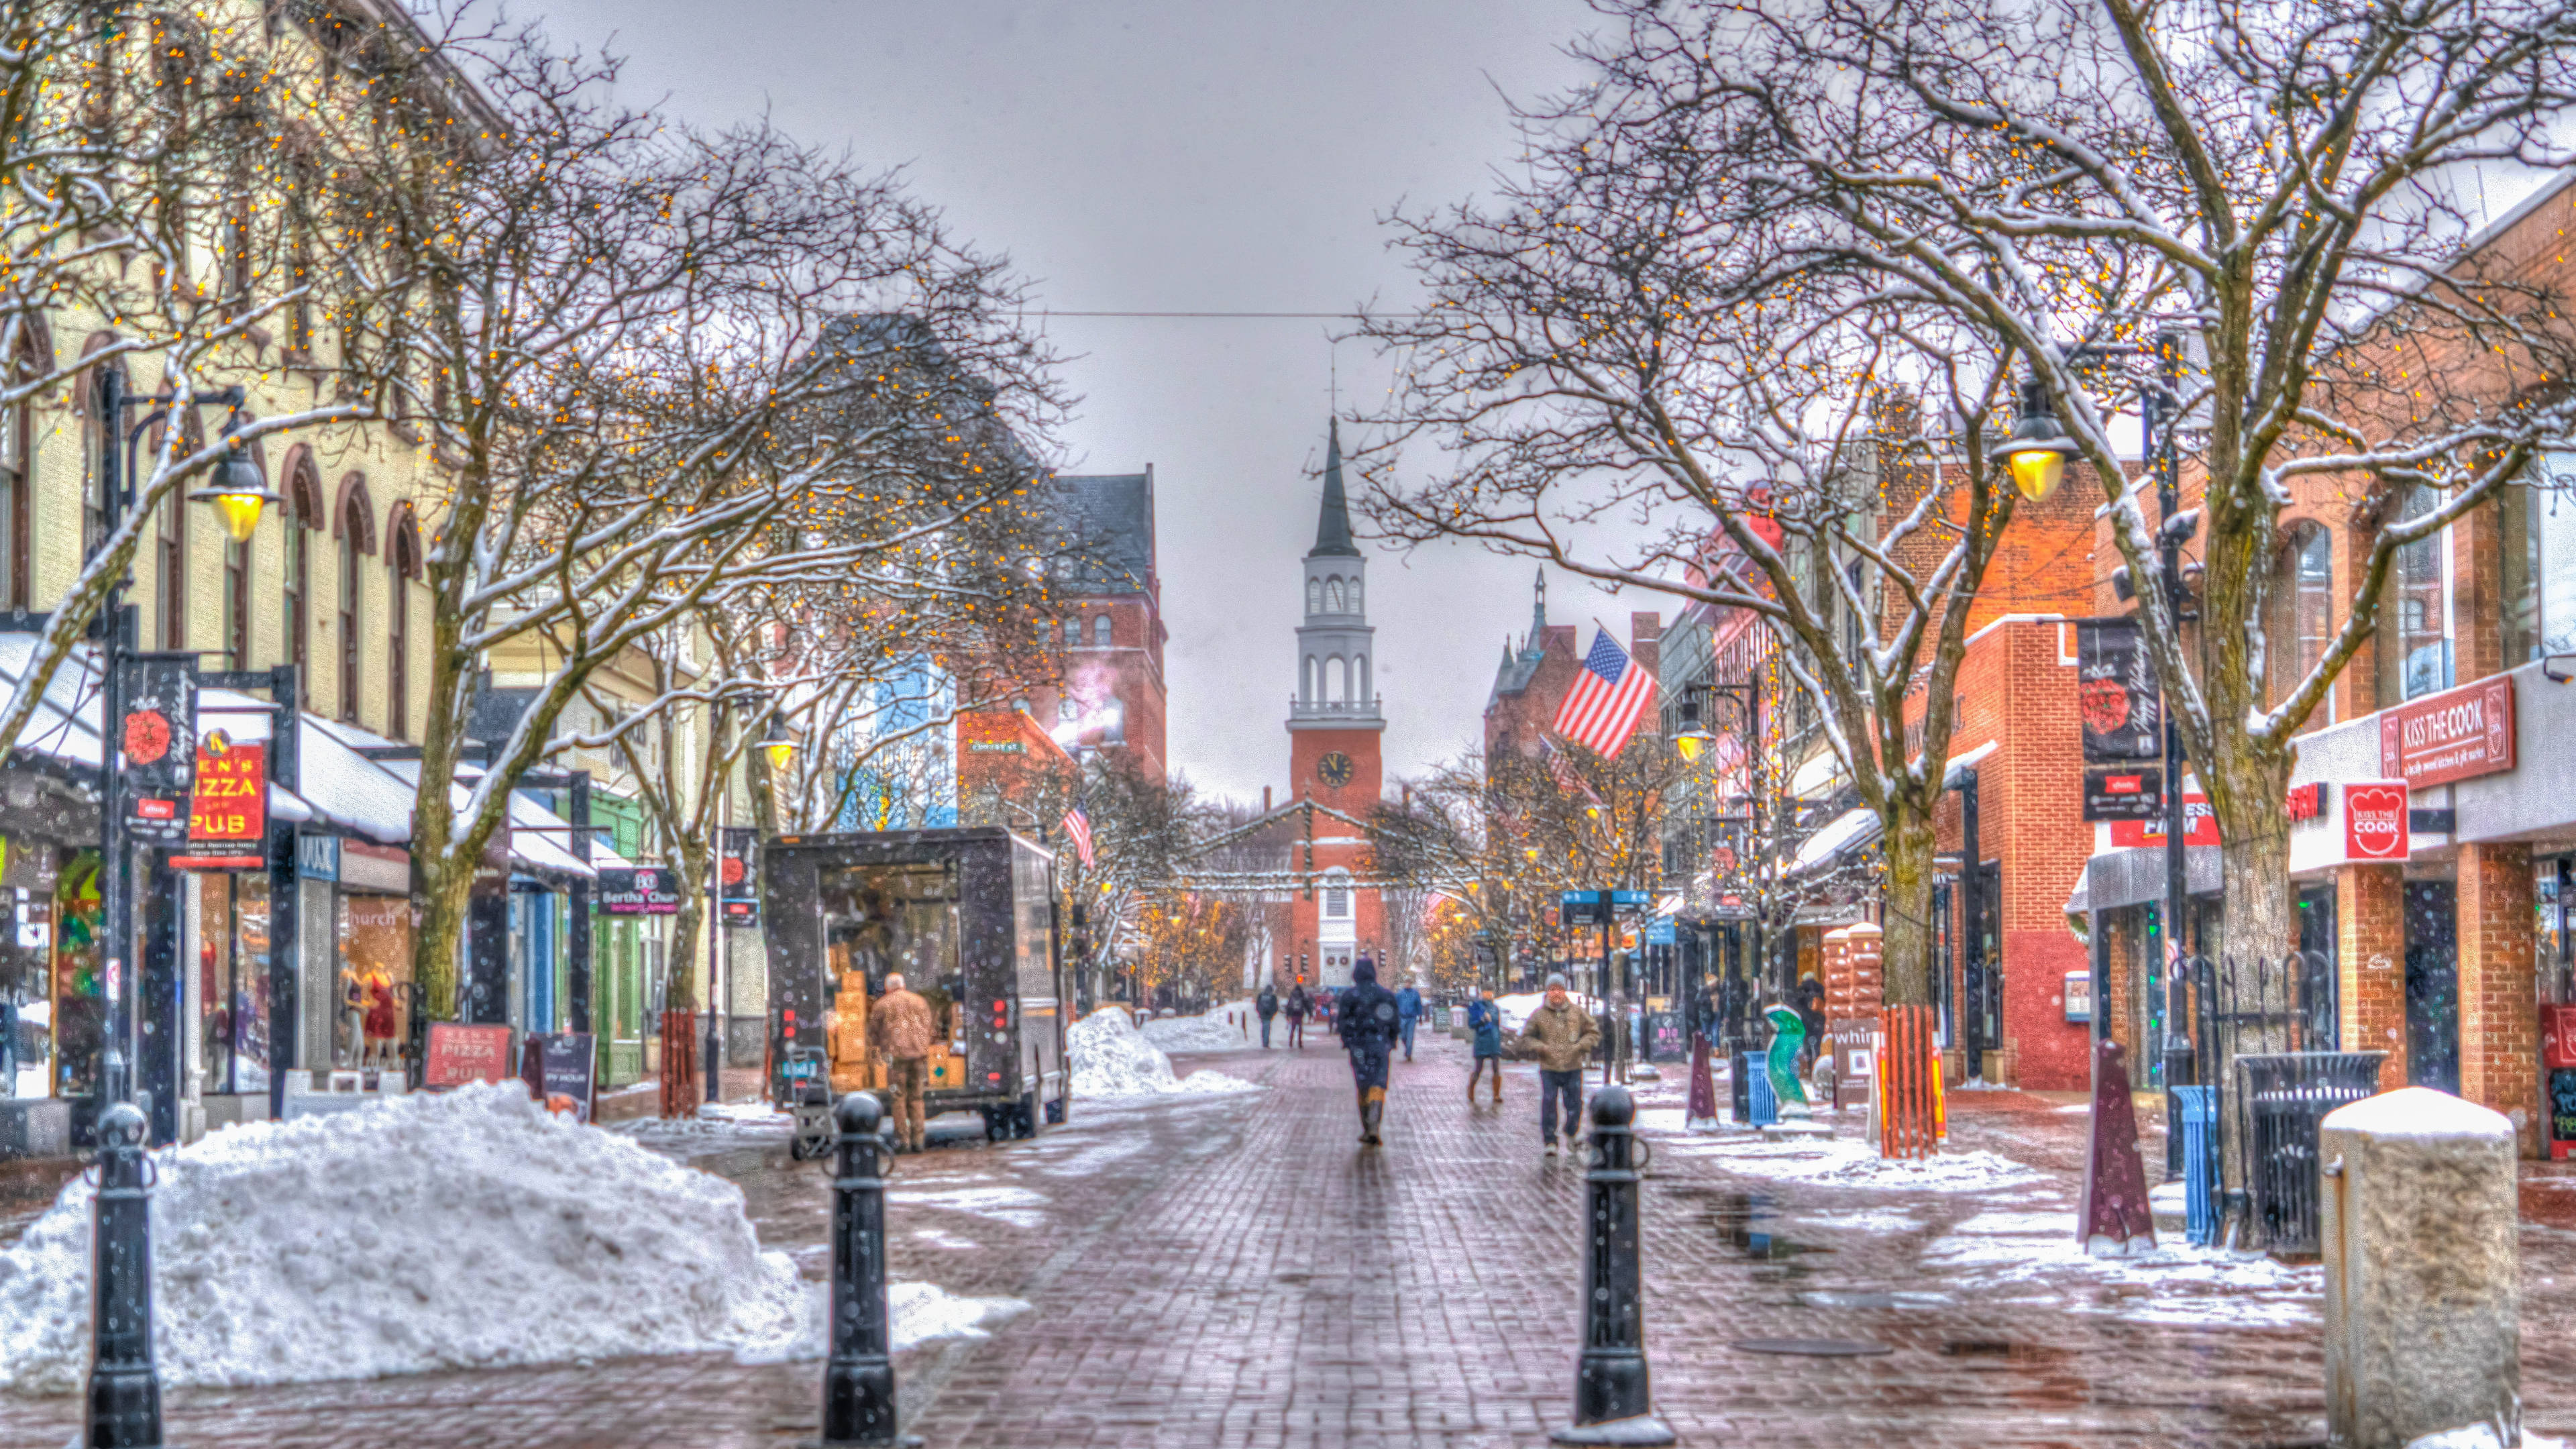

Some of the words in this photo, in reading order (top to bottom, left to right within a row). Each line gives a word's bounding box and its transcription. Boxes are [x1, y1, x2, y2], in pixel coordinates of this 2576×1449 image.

[2404, 716, 2426, 749] KISS
[2426, 710, 2447, 742] THE
[2448, 698, 2483, 737] COOK
[199, 759, 254, 773] EN'S
[195, 779, 256, 796] IZZA
[2354, 821, 2400, 833] COOK
[603, 892, 644, 904] Bertha
[349, 912, 396, 926] hurch
[441, 1043, 495, 1058] PIZZA
